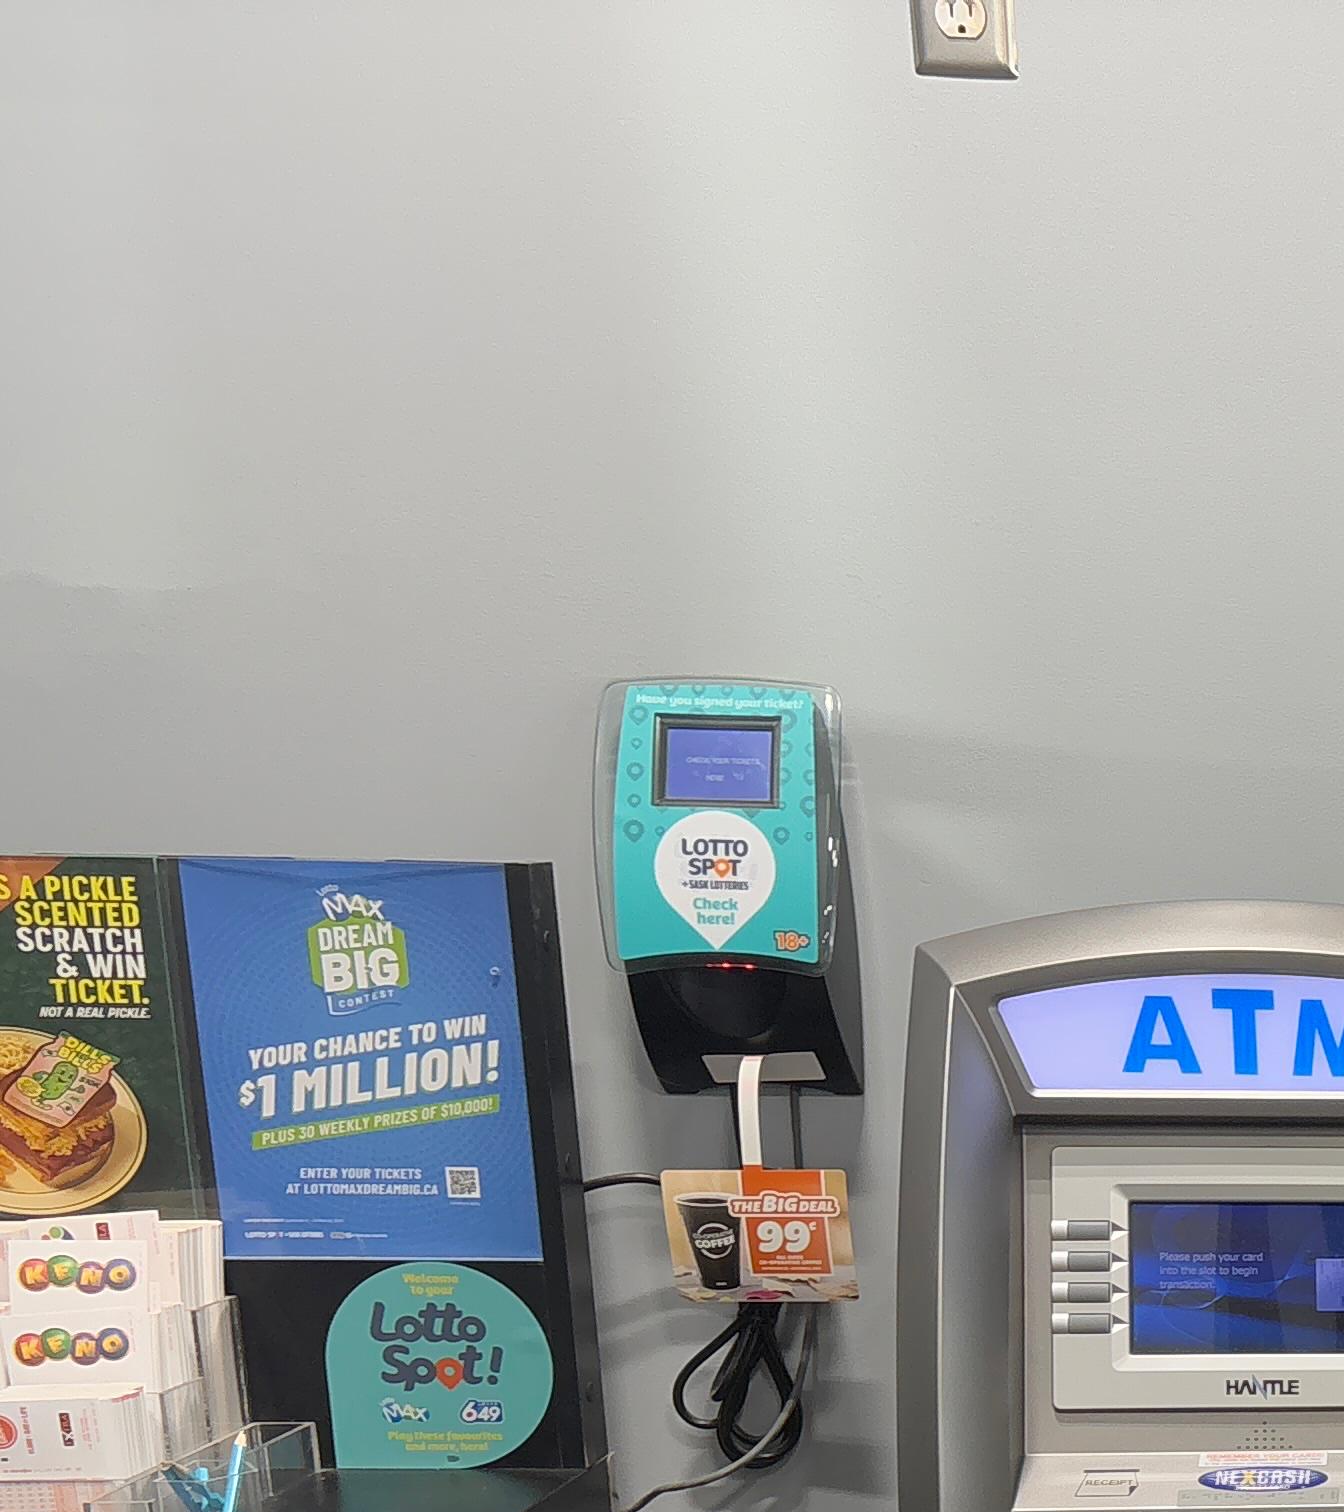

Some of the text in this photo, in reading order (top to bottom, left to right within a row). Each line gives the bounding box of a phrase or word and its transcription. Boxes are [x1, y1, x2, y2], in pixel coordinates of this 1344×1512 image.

[669, 696, 692, 707] you
[681, 838, 748, 857] LOTTO
[689, 858, 741, 878] SPOT
[20, 876, 138, 901] A PICKLE
[14, 901, 140, 927] SCENTED
[322, 892, 384, 921] MAX
[692, 897, 739, 911] Check
[697, 911, 735, 925] here!
[17, 927, 143, 952] SCRATCH
[318, 921, 394, 951] DREAM
[56, 954, 146, 978] & WIN
[321, 948, 400, 993] BIG
[49, 979, 150, 1004] TICKET.
[337, 989, 395, 1009] CONTEST
[39, 1006, 151, 1019] NOT A REAL PICKLE.
[248, 1014, 487, 1070] YOUR CHANCE TO WIN
[239, 1040, 500, 1118] $1 MILLION!
[261, 1098, 493, 1146] PLUS 30 WEEKLY PRIZES OF $10,000!
[299, 1167, 423, 1180] ENTER YOUR TICKETS
[286, 1183, 301, 1195] AT
[733, 1195, 834, 1213] THE BIG DEAL
[694, 1237, 735, 1249] COFFEE
[1159, 1252, 1264, 1263] Please push your card
[22, 1259, 134, 1289] KENO
[1159, 1266, 1259, 1277] into the slot to begin
[370, 1301, 486, 1343] Lotto
[18, 1332, 126, 1363] KENO
[1225, 1374, 1300, 1400] HANTLE
[1085, 1479, 1133, 1487] RECEIPT
[1215, 1469, 1312, 1486] NEXCASH
